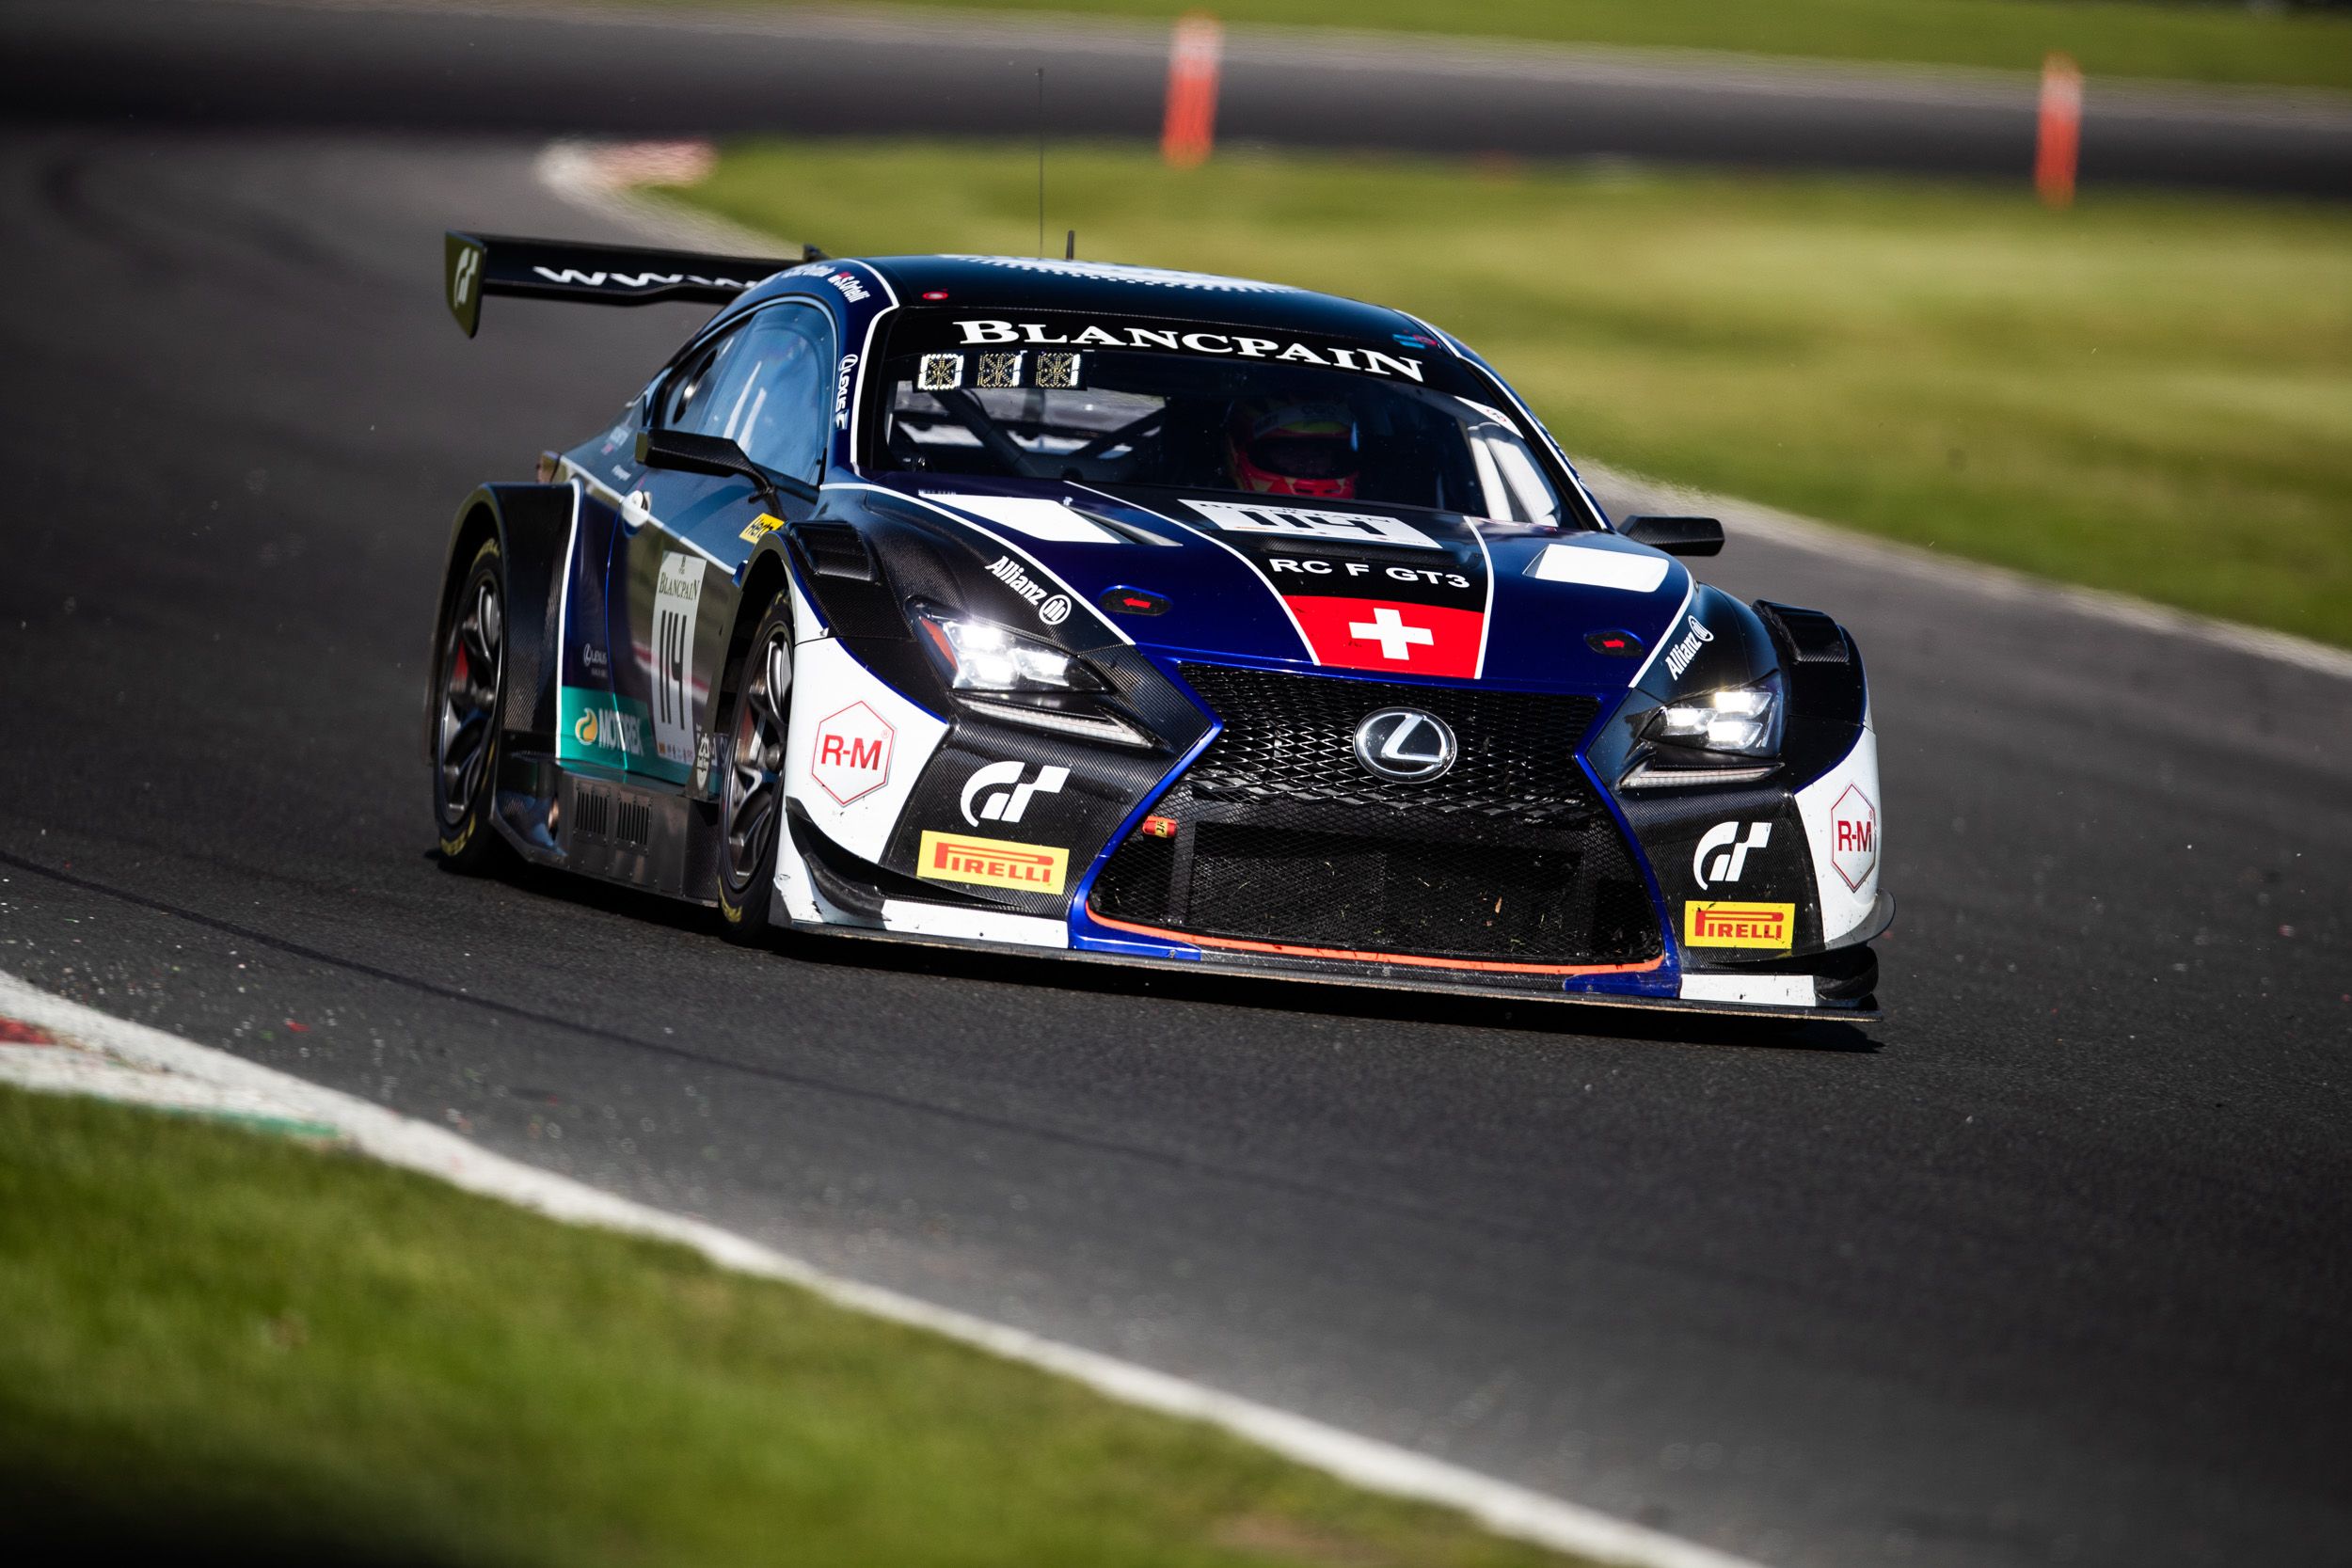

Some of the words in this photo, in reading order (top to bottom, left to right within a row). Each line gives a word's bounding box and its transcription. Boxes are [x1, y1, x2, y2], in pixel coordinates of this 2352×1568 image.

[952, 320, 1423, 383] BLANCPAIN
[1240, 511, 1389, 535] 114
[659, 572, 701, 600] BLANCPAIN
[984, 555, 1048, 606] Allianz
[1269, 558, 1333, 575] RC
[1345, 562, 1371, 576] F
[1386, 567, 1470, 588] GT3
[659, 610, 688, 731] 114
[1664, 631, 1703, 681] Allianz
[820, 734, 882, 771] R-M
[1837, 820, 1872, 853] R-M
[933, 842, 1055, 883] PIRELLI
[1694, 910, 1785, 940] PIRELLI
